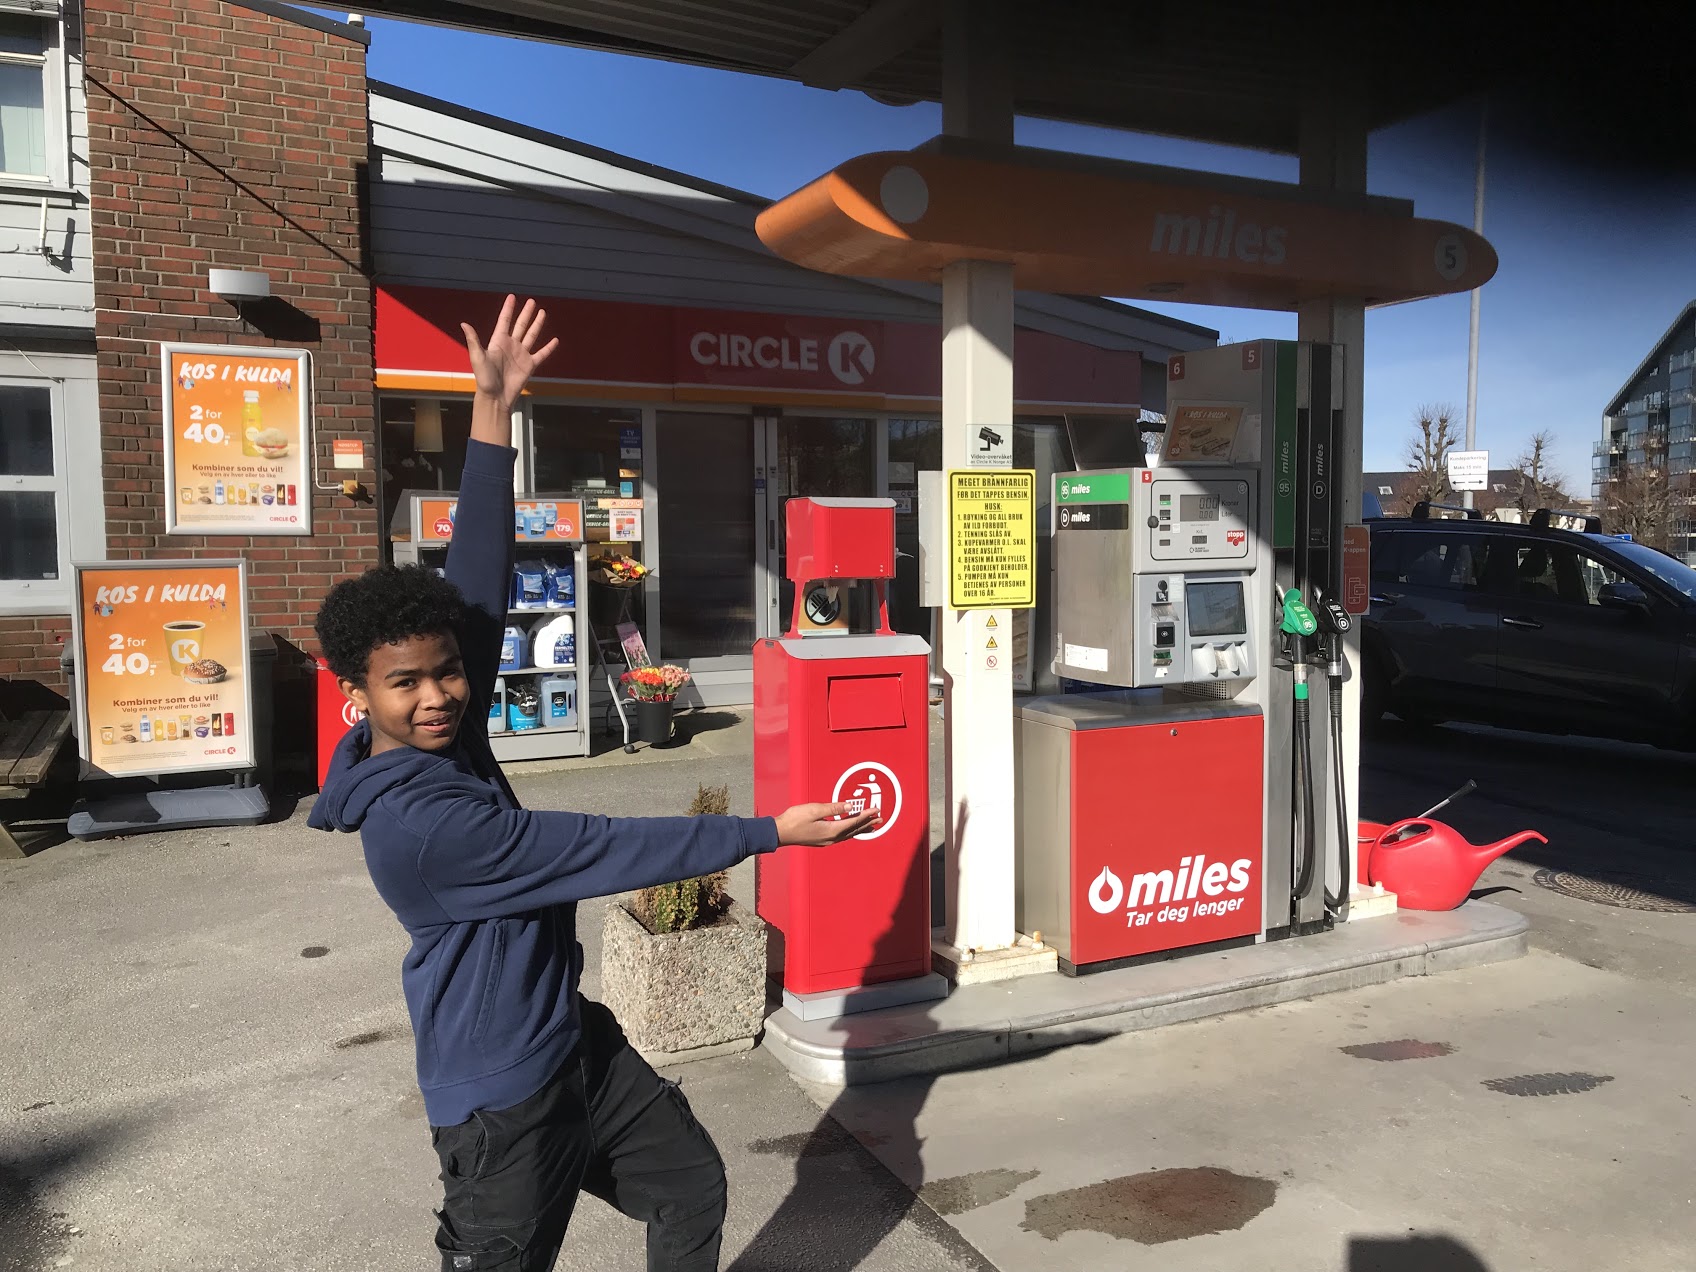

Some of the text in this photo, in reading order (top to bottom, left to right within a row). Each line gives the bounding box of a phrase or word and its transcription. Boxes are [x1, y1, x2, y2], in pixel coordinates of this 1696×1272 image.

[1150, 204, 1288, 264] miles
[1446, 245, 1457, 270] 5
[690, 332, 875, 384] CIRCLE K
[1247, 350, 1255, 363] 5
[179, 361, 292, 384] KOS I KULDA
[1173, 362, 1180, 375] 6
[190, 405, 222, 420] 2 for
[1280, 440, 1289, 473] miles
[1316, 443, 1324, 476] miles
[192, 464, 235, 472] Kombiner
[957, 477, 1029, 487] MEGET BRANNFARLIG
[1279, 483, 1290, 493] 95
[957, 491, 969, 499] FØR
[1006, 491, 1029, 499] BENSIN.
[1061, 484, 1091, 495] 95 miles
[1315, 486, 1323, 495] D
[963, 513, 987, 521] RØYKING
[1008, 513, 1023, 521] BRUK
[1062, 511, 1091, 522] D miles
[989, 529, 1002, 537] SLÅS
[963, 563, 971, 572] PÅ
[988, 571, 996, 579] MÅ
[963, 581, 988, 589] BETJENES
[95, 583, 227, 605] KOS I KULDA
[108, 633, 147, 650] 2 for
[174, 640, 199, 664] K
[113, 697, 162, 707] Kombiner
[188, 694, 201, 703] du
[203, 693, 219, 701] vil!
[204, 746, 236, 756] CIRCLE K
[1126, 854, 1252, 909] miles
[1126, 897, 1245, 928] Tar deg lenger
